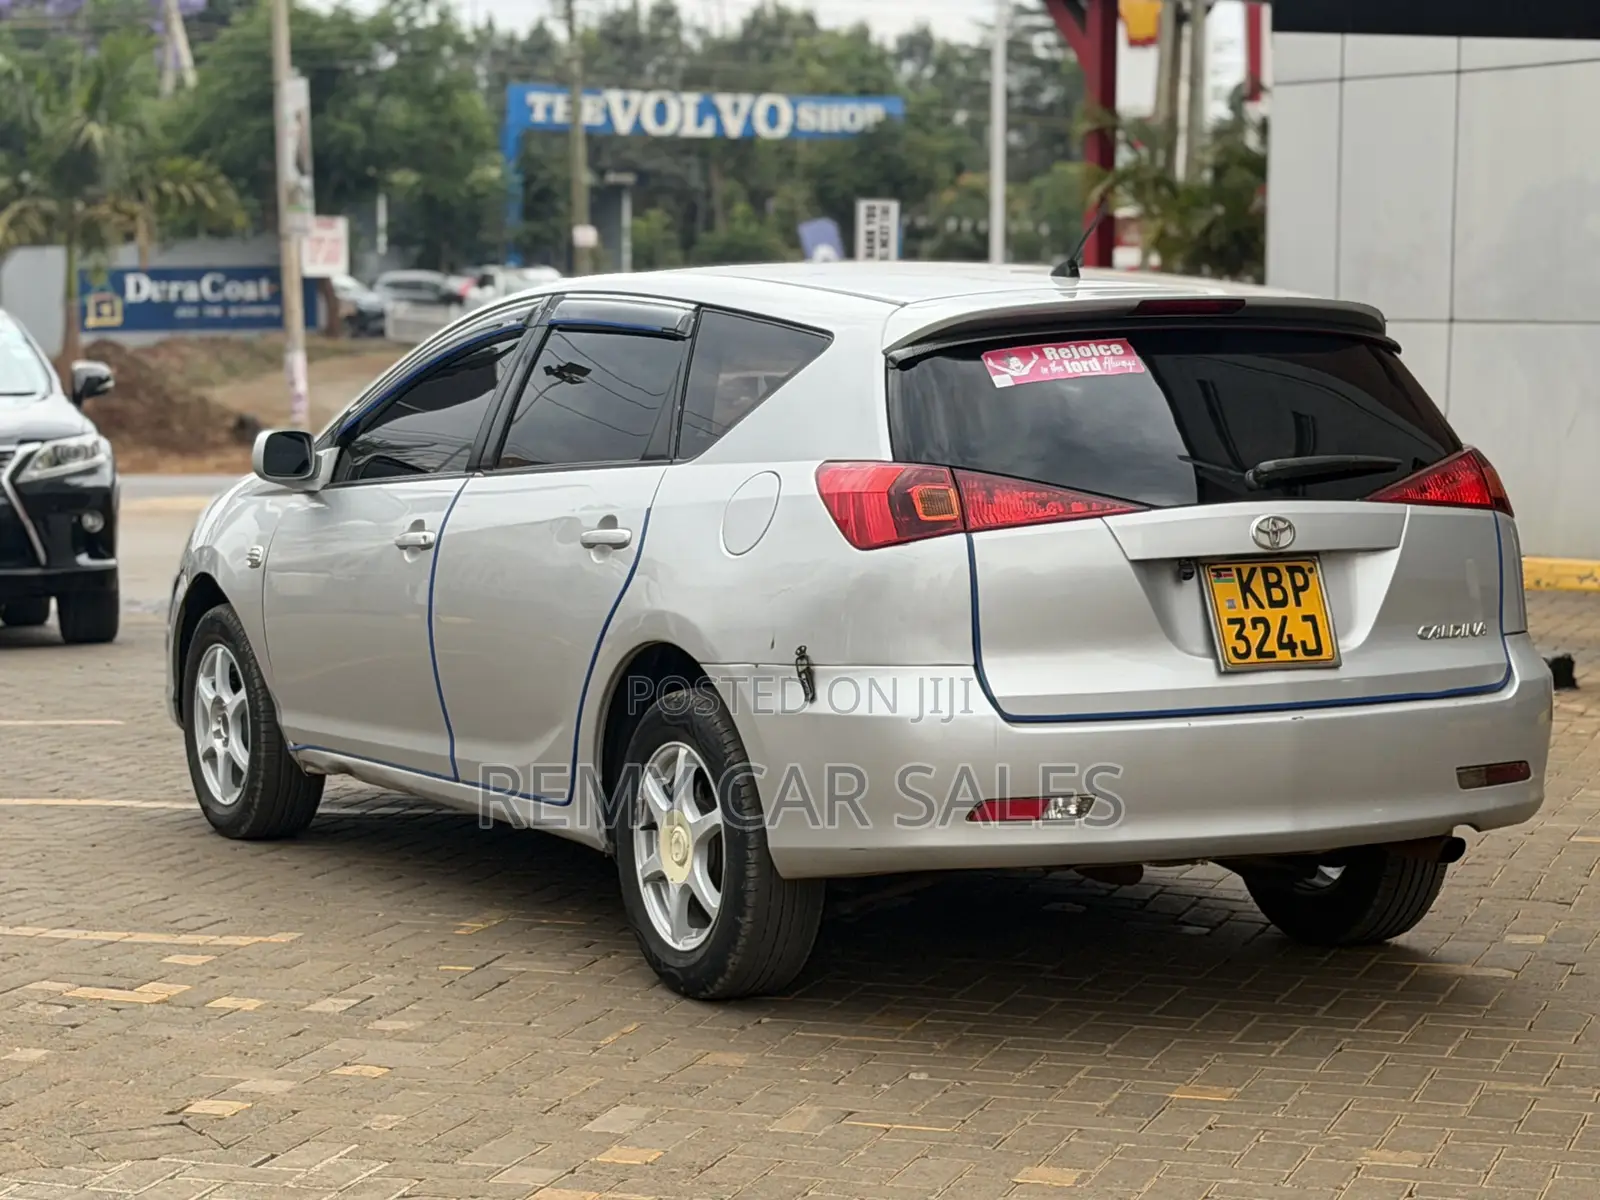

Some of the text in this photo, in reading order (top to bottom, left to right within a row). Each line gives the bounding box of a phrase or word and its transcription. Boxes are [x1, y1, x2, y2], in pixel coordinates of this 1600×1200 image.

[602, 88, 793, 139] VOLVO
[796, 101, 886, 133] SHOP
[124, 271, 272, 304] DuraCoat
[1042, 344, 1124, 361] Rejoice
[1064, 357, 1102, 374] lord
[1235, 565, 1310, 610] KBP
[1226, 614, 1323, 660] 324J
[1417, 621, 1487, 640] CALDINA
